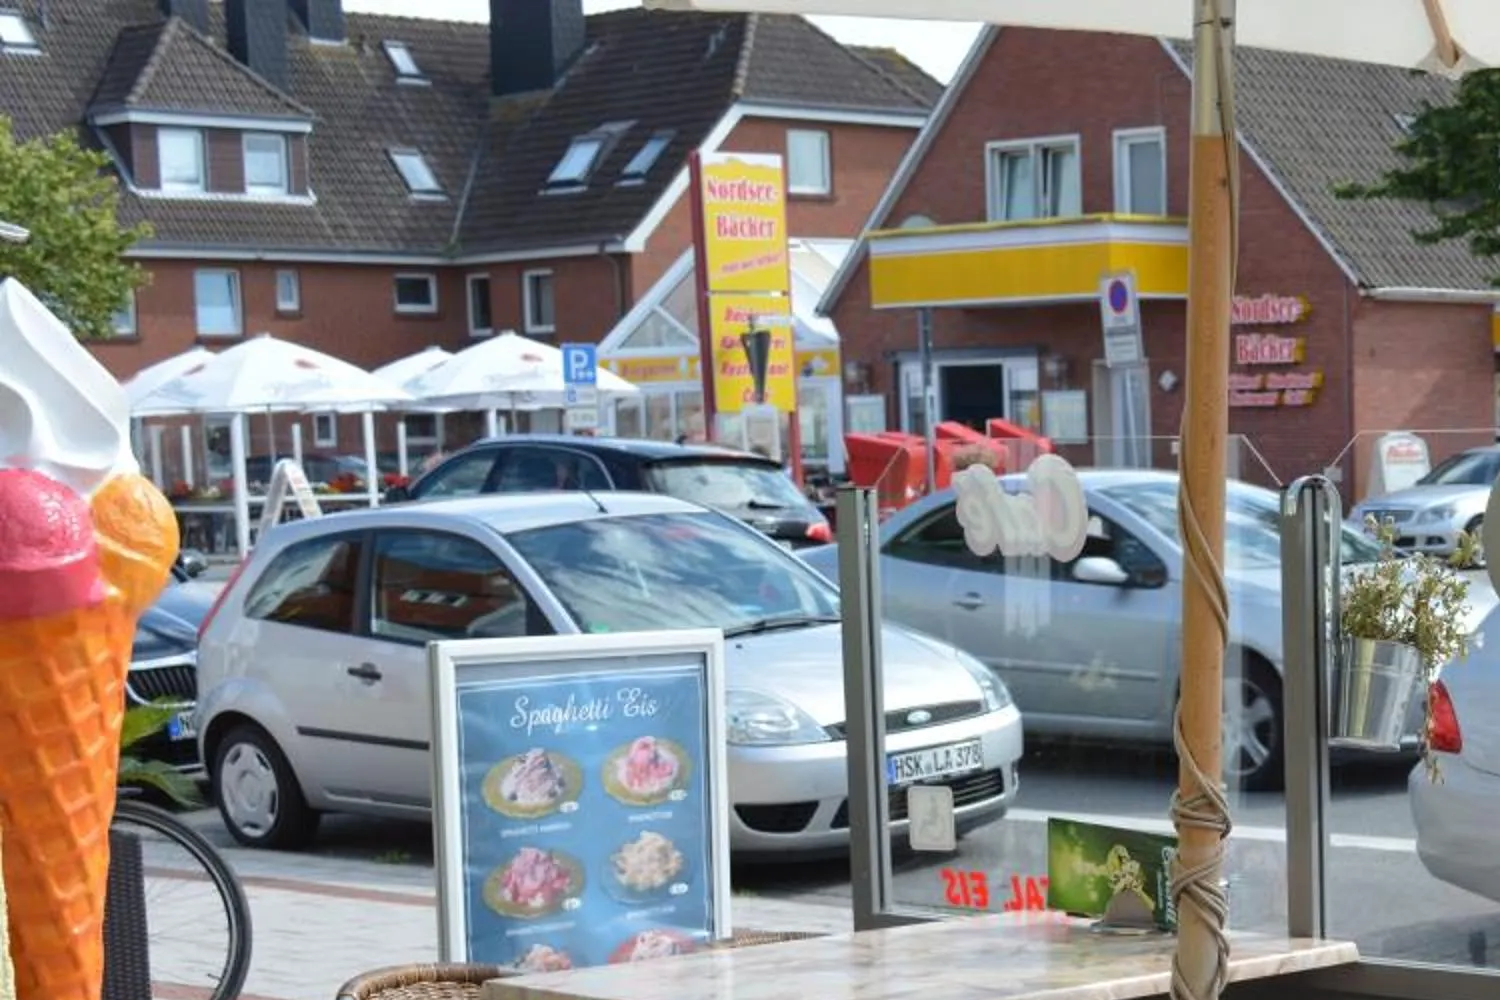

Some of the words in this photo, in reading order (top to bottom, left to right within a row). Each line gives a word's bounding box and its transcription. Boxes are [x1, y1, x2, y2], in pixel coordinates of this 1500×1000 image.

[716, 214, 775, 239] Bäcker
[510, 693, 611, 736] Spaghetti
[617, 688, 659, 717] Eis
[895, 756, 923, 779] HSK
[933, 749, 953, 771] LA
